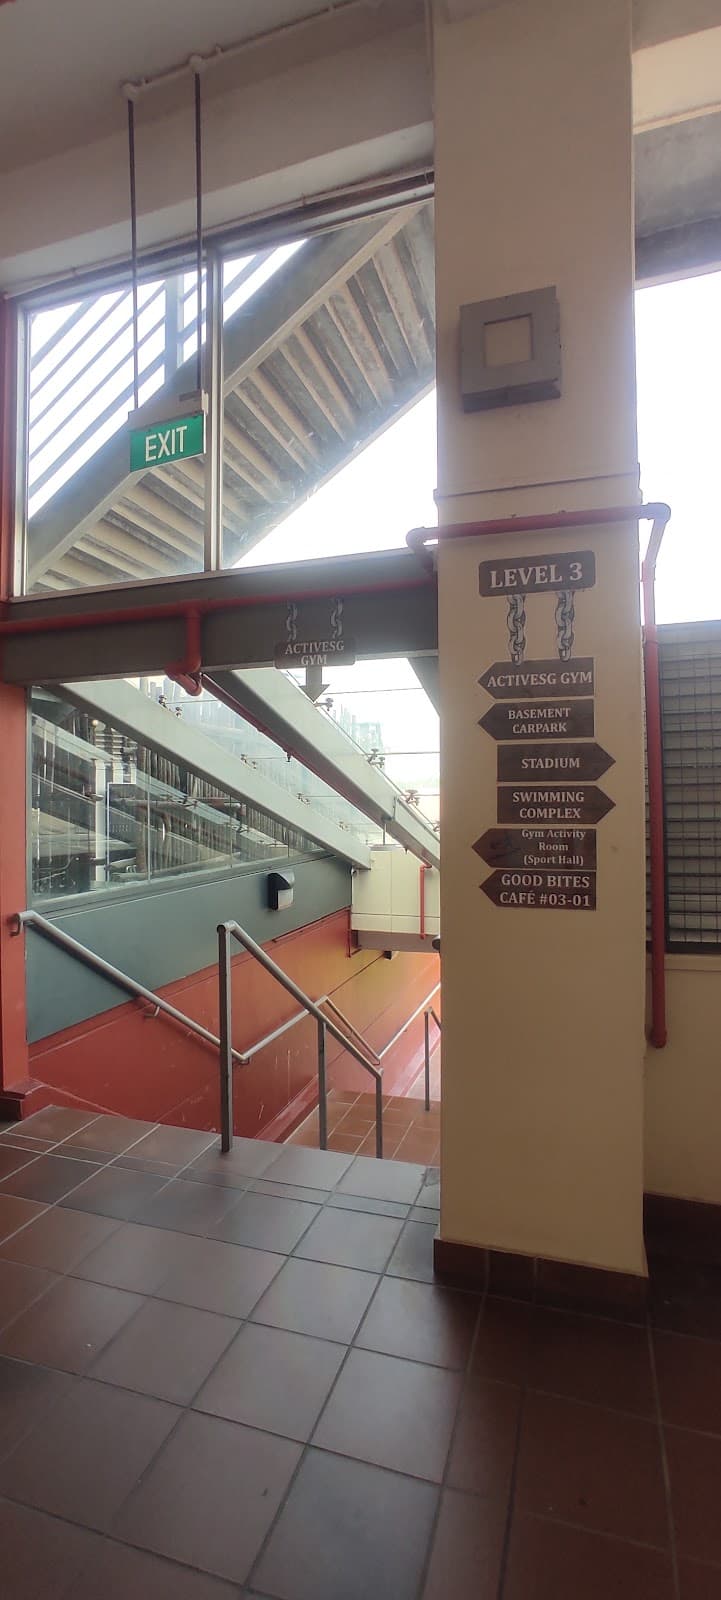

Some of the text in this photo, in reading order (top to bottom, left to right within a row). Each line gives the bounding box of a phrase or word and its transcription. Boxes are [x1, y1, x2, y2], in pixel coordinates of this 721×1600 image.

[146, 426, 187, 461] EXIT
[490, 562, 583, 588] LEVEL 3
[285, 641, 344, 654] ACTIVESG
[301, 655, 327, 665] GYM
[487, 671, 593, 688] ACTIVESG GYM
[508, 707, 571, 720] BASEMENT
[512, 722, 567, 734] CARPARK
[521, 758, 580, 769] STADIUM
[512, 791, 585, 802] SWIMMING
[519, 808, 581, 818] COMPLEX
[521, 829, 586, 840] Gym Activity
[538, 842, 569, 851] Room
[523, 855, 584, 866] (Sport Hall)
[501, 874, 590, 888] GOOD BITES
[500, 890, 590, 907] CAFÉ #03-01
